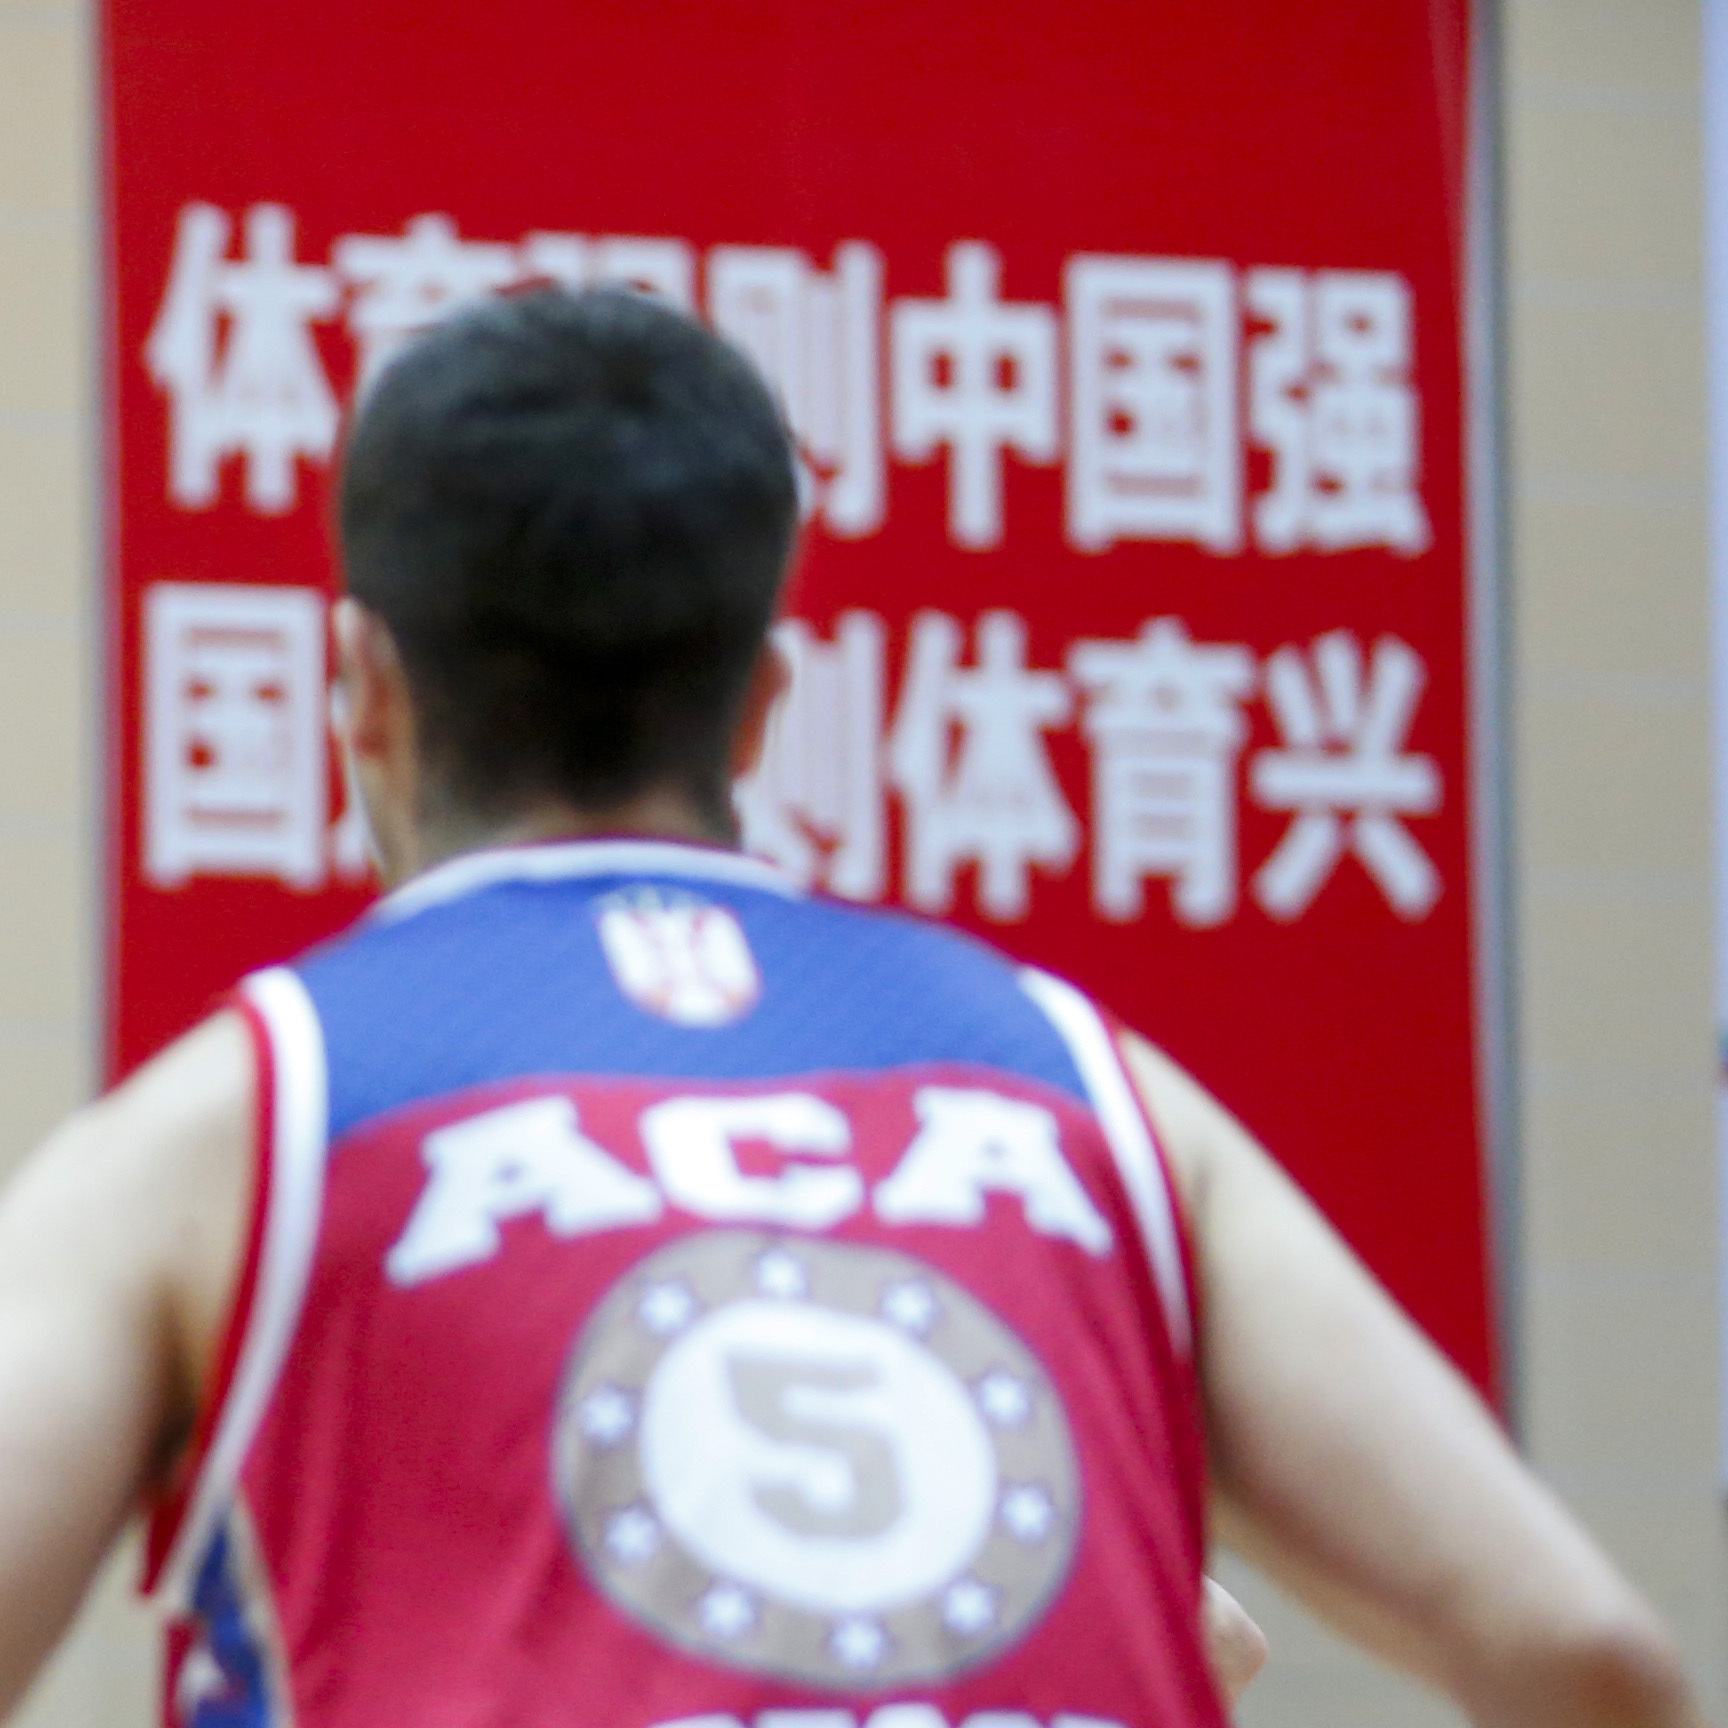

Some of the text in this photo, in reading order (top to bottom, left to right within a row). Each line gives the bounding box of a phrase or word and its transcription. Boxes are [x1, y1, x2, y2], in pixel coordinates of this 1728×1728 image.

[146, 203, 1430, 556] 体则中国强
[144, 580, 1441, 924] 国则体育兴
[386, 1086, 1112, 1288] ACA
[720, 1346, 909, 1541] 5
